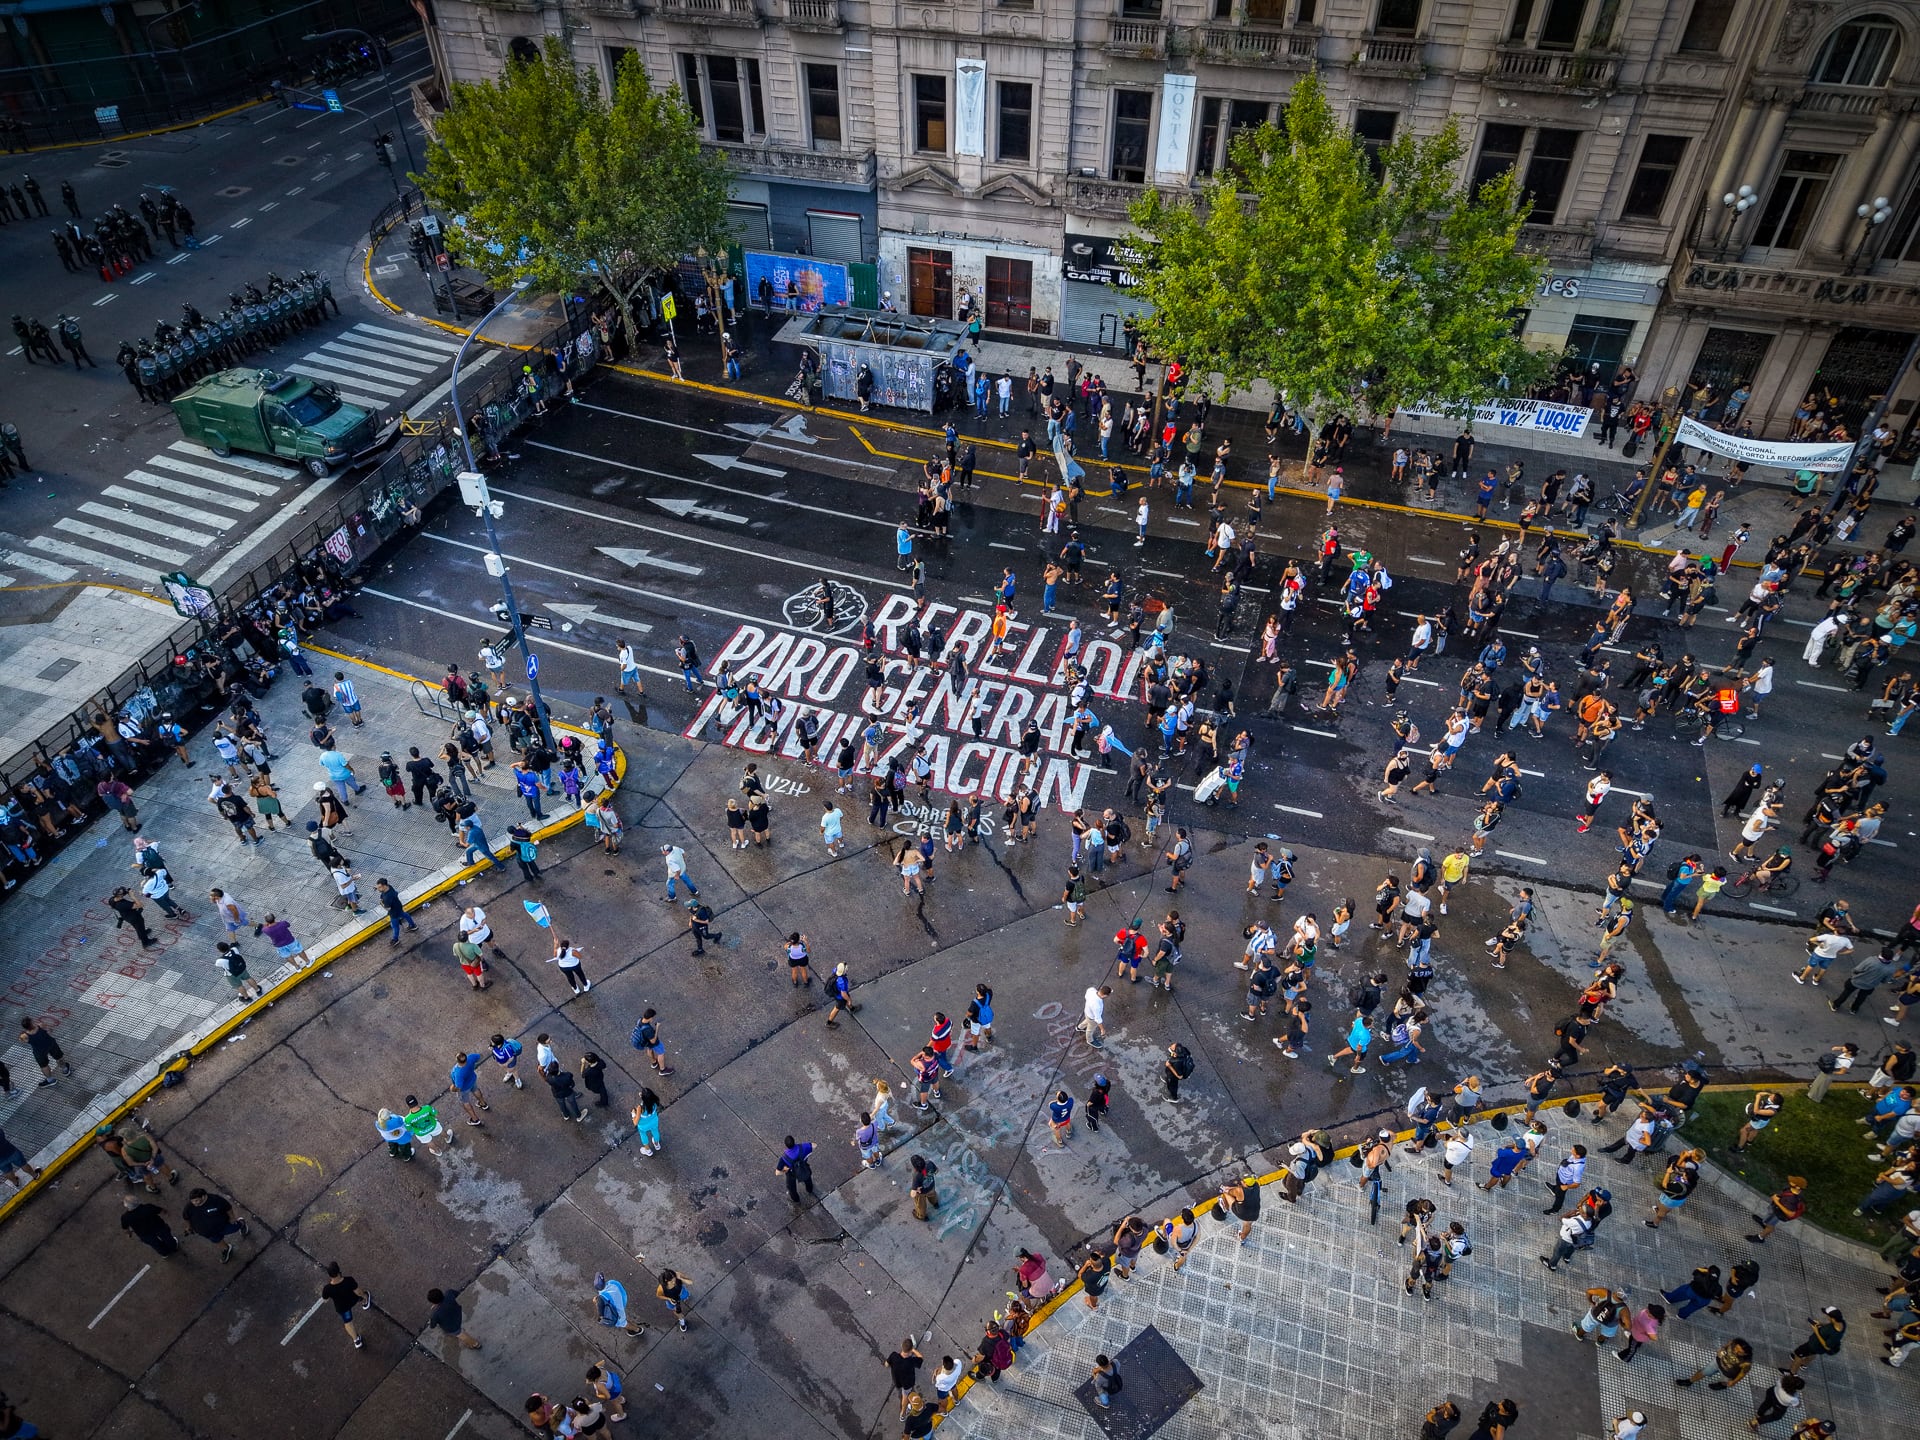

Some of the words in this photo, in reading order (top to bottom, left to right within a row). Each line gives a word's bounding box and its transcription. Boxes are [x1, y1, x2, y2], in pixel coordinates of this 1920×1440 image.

[1167, 77, 1185, 164] HOSTAL
[1067, 272, 1112, 282] CAFE
[1500, 410, 1531, 426] YA!!
[1535, 408, 1585, 432] LUQUE
[1707, 433, 1738, 448] INDUSTRIA
[1745, 451, 1765, 460] ORTO
[708, 625, 859, 703] PARO
[859, 658, 1092, 760] GENERAL
